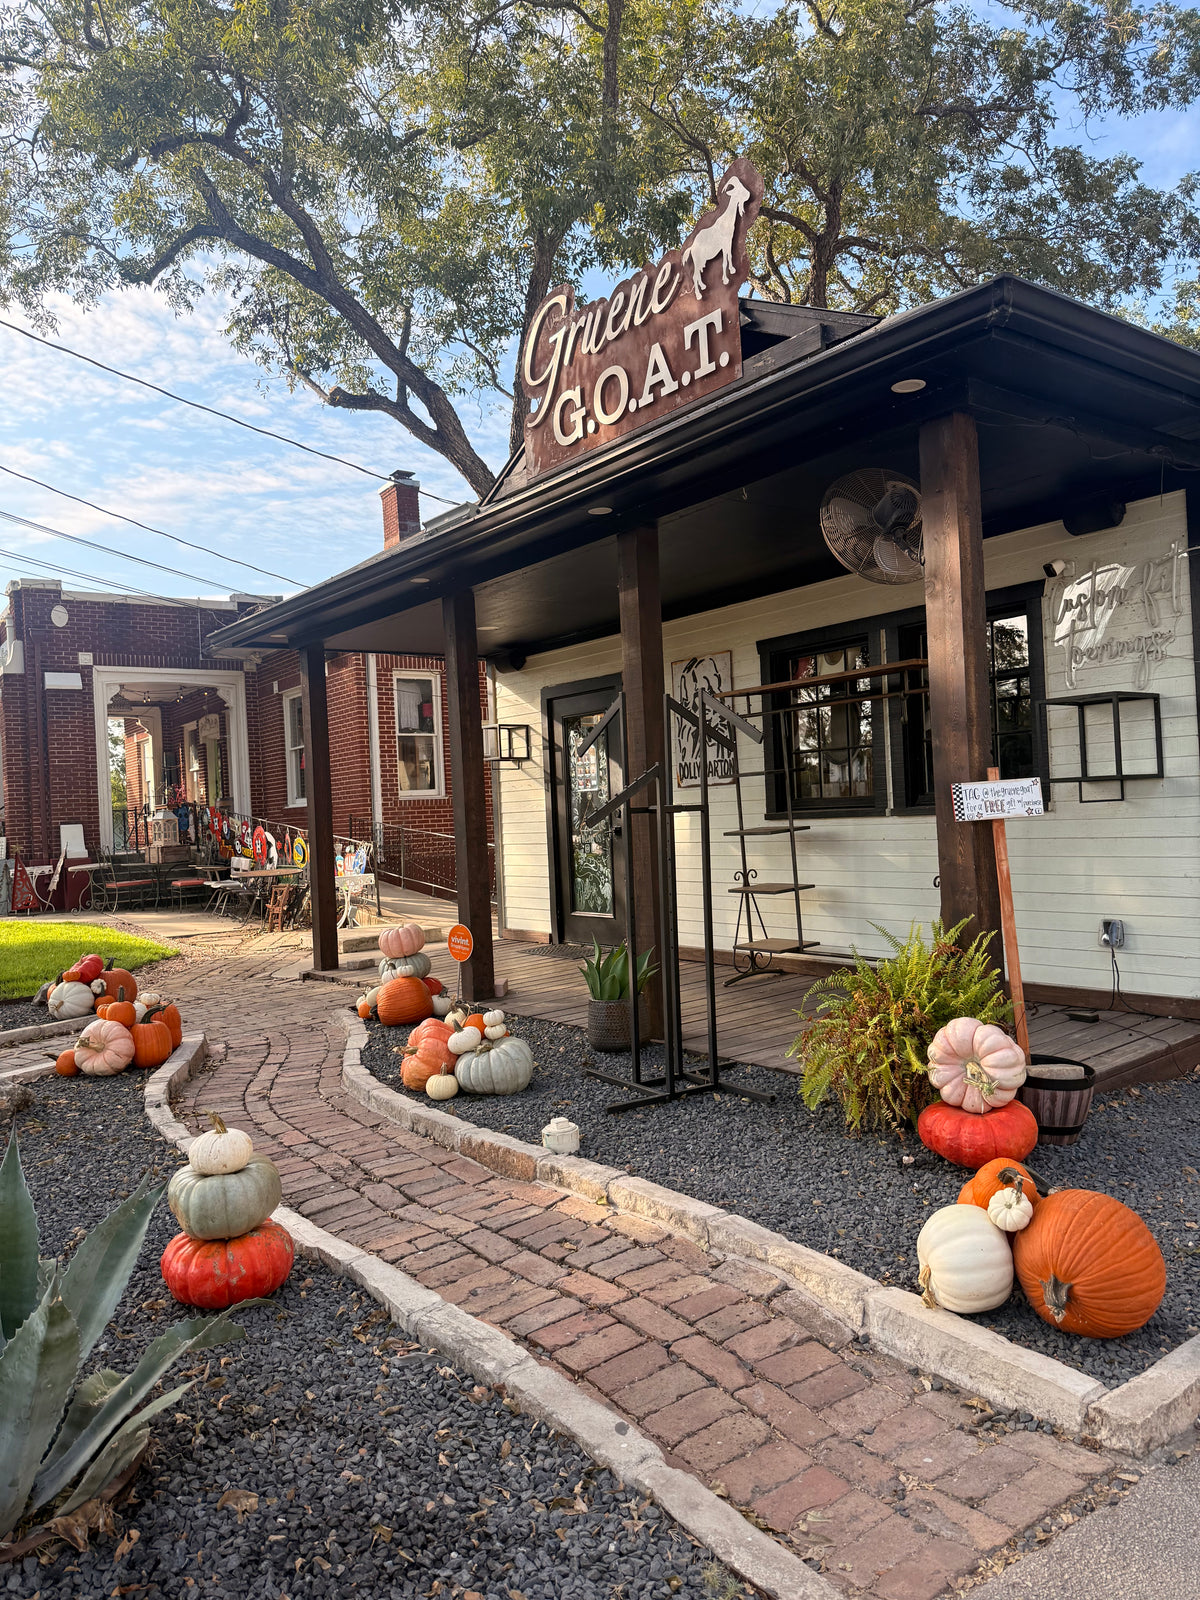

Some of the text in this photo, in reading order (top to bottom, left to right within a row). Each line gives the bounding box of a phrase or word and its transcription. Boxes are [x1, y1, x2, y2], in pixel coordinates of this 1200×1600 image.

[524, 261, 682, 428] Gruene
[553, 308, 730, 446] G.O.A.T.
[679, 758, 734, 780] DOLLY ARTON
[962, 787, 980, 801] TAG
[966, 802, 977, 812] for
[978, 803, 983, 811] a
[983, 799, 1006, 813] FREE
[1006, 797, 1016, 808] gift
